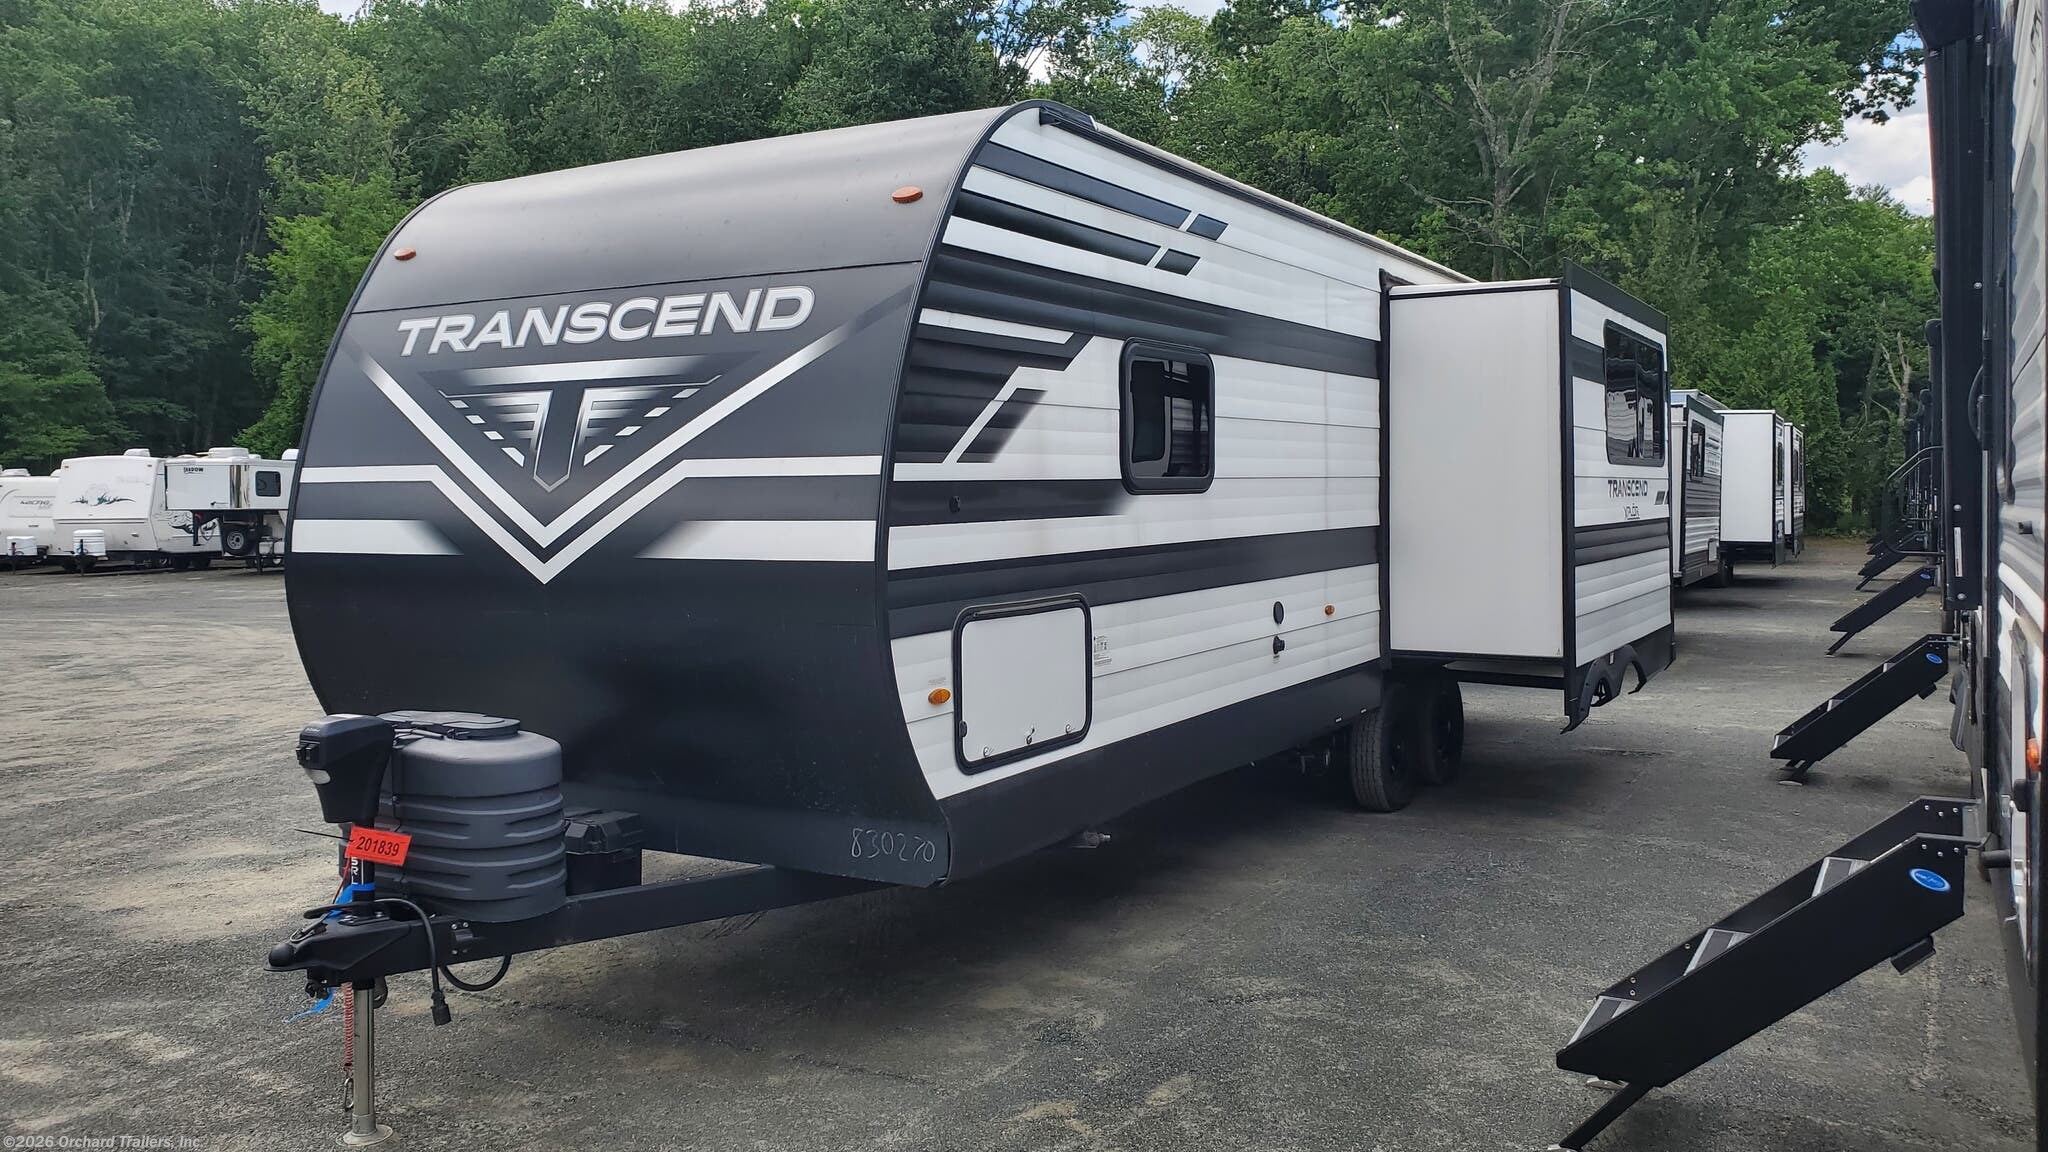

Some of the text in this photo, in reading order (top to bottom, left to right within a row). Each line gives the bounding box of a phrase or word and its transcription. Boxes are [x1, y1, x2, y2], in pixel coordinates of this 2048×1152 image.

[397, 285, 816, 356] TRANSCEND
[1607, 479, 1649, 499] TRANSCEND
[356, 836, 400, 858] 201839
[851, 827, 936, 863] 830270
